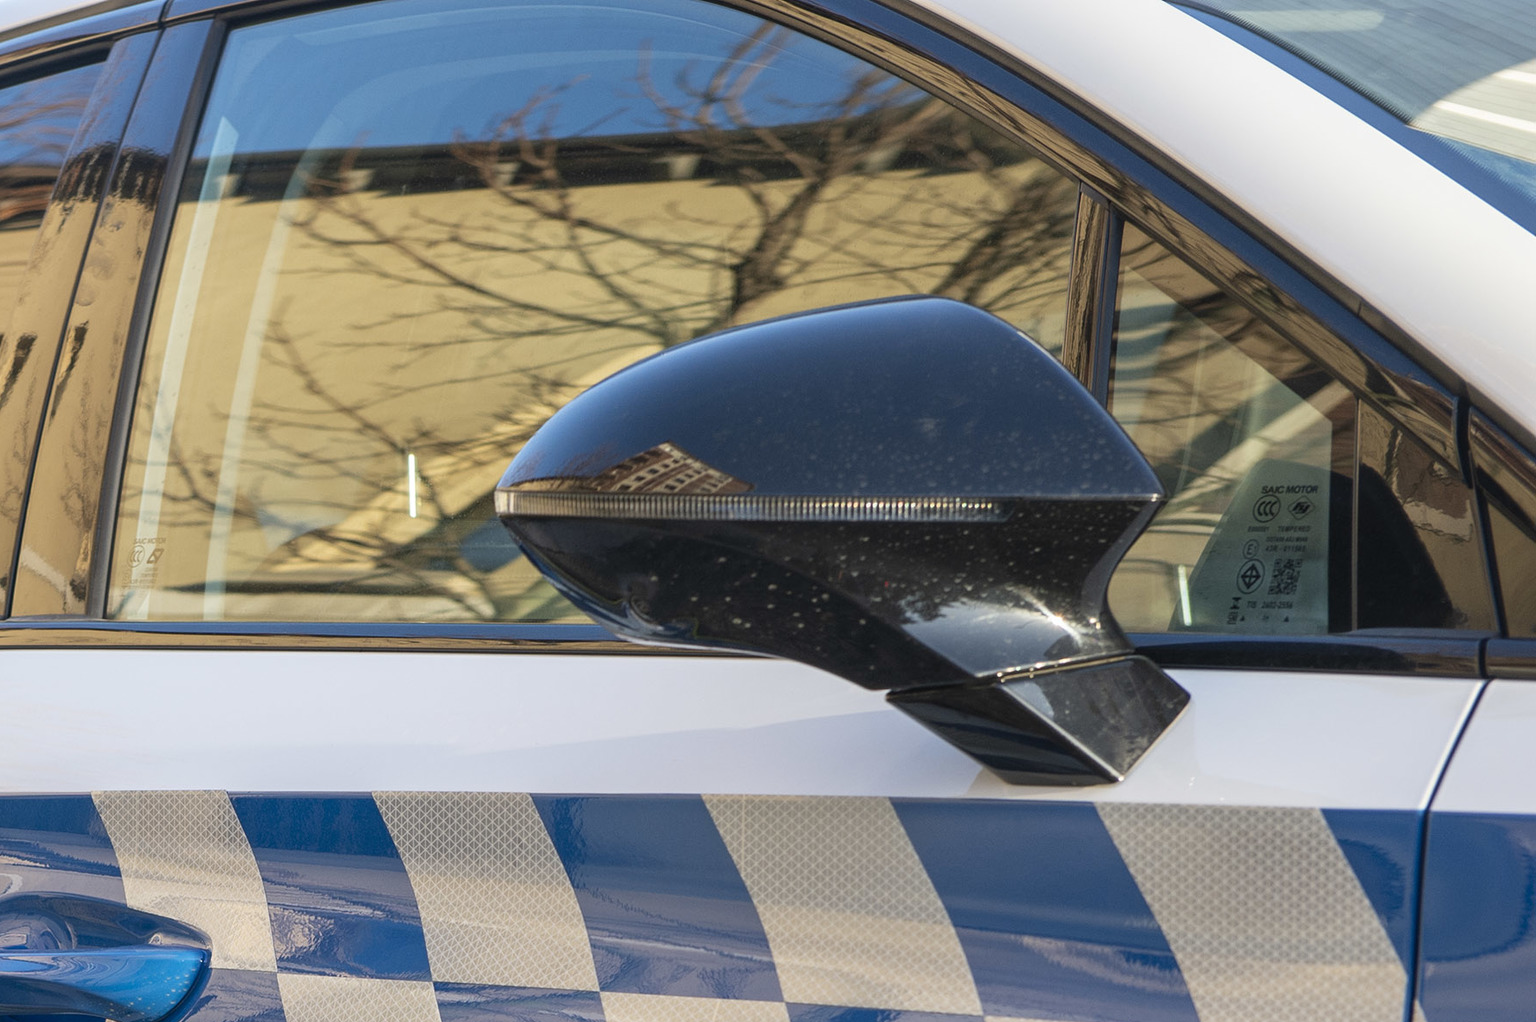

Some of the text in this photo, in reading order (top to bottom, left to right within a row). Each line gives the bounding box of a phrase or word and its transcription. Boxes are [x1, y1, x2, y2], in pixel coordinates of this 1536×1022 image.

[1261, 484, 1319, 494] SAIC MOTOR
[1277, 525, 1311, 533] TEMPERED
